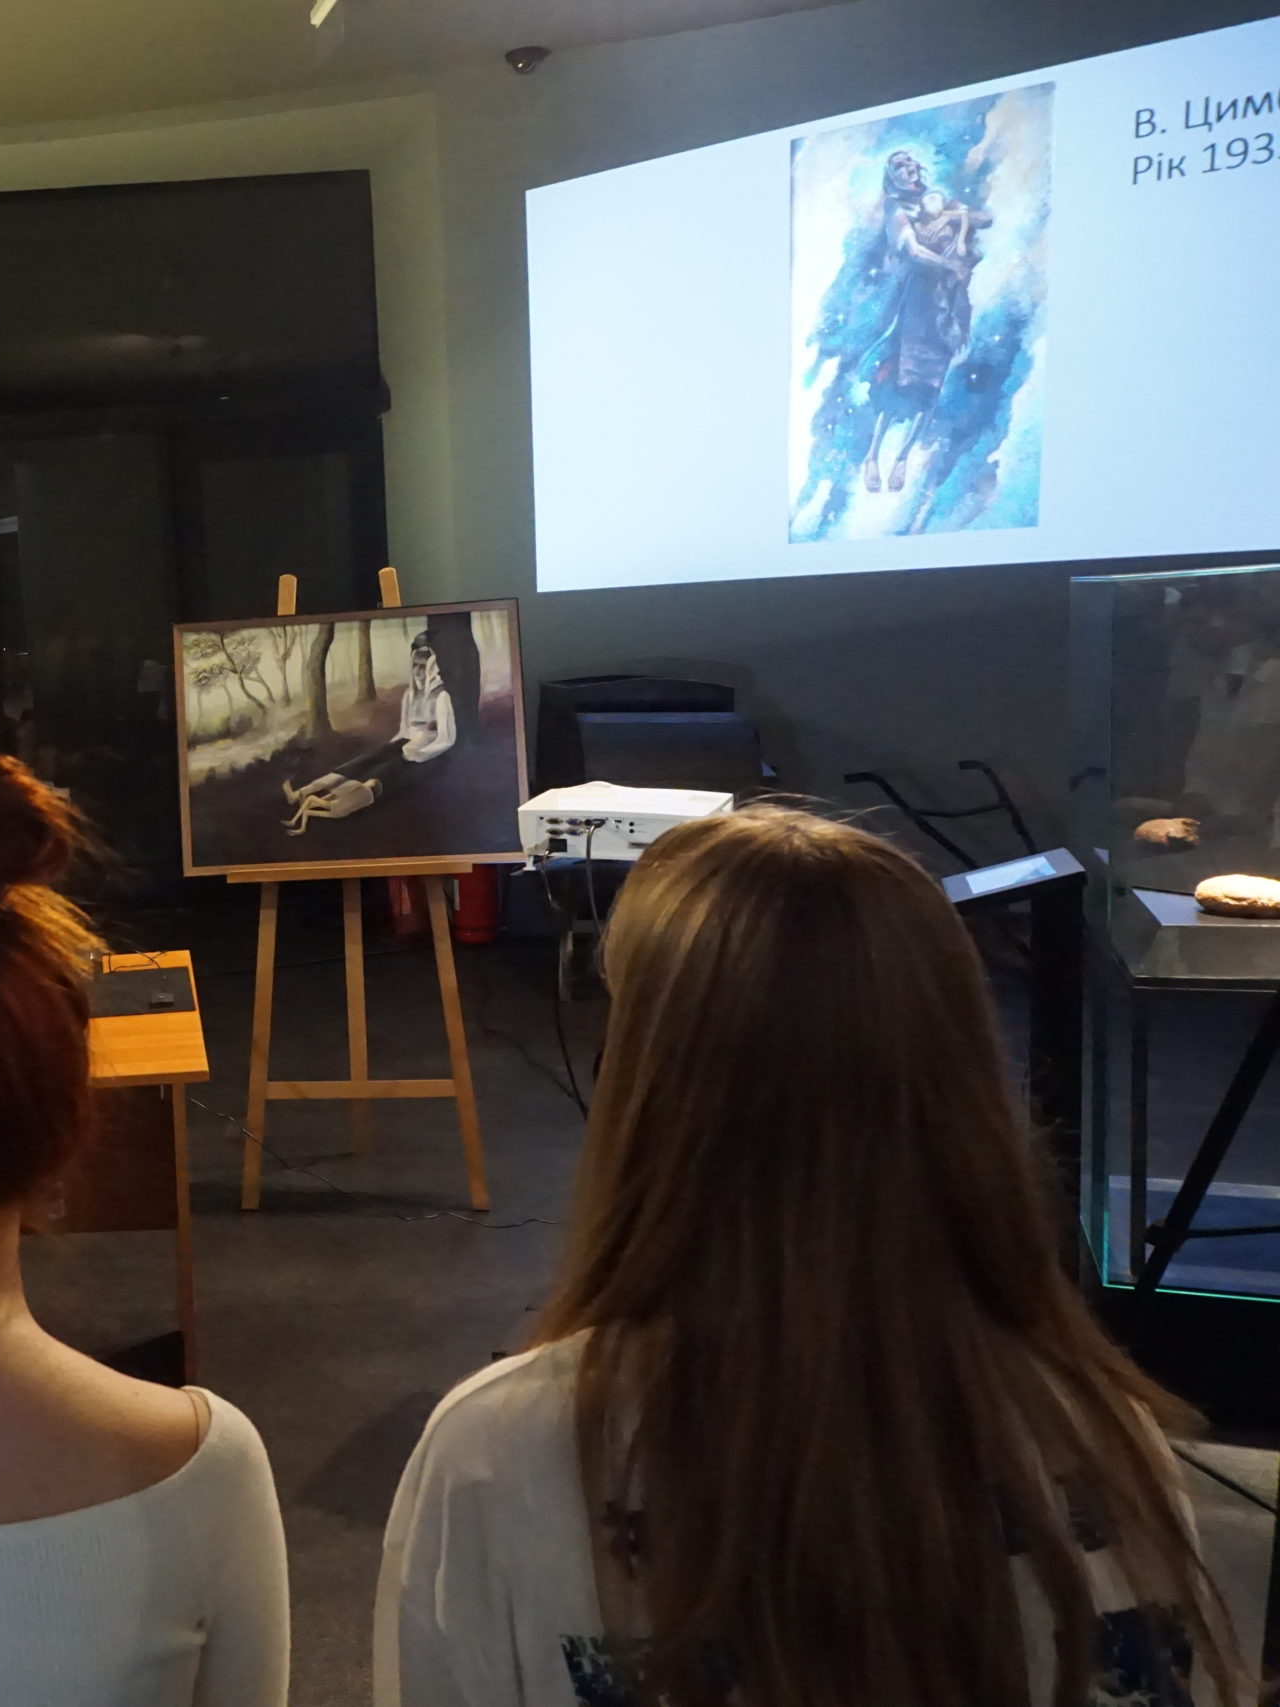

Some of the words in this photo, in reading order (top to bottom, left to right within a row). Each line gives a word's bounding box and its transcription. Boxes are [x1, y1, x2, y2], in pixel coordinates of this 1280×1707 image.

[1134, 108, 1167, 139] В.
[1184, 87, 1280, 132] Цим
[1132, 152, 1186, 185] Рік
[1202, 132, 1280, 174] 193
